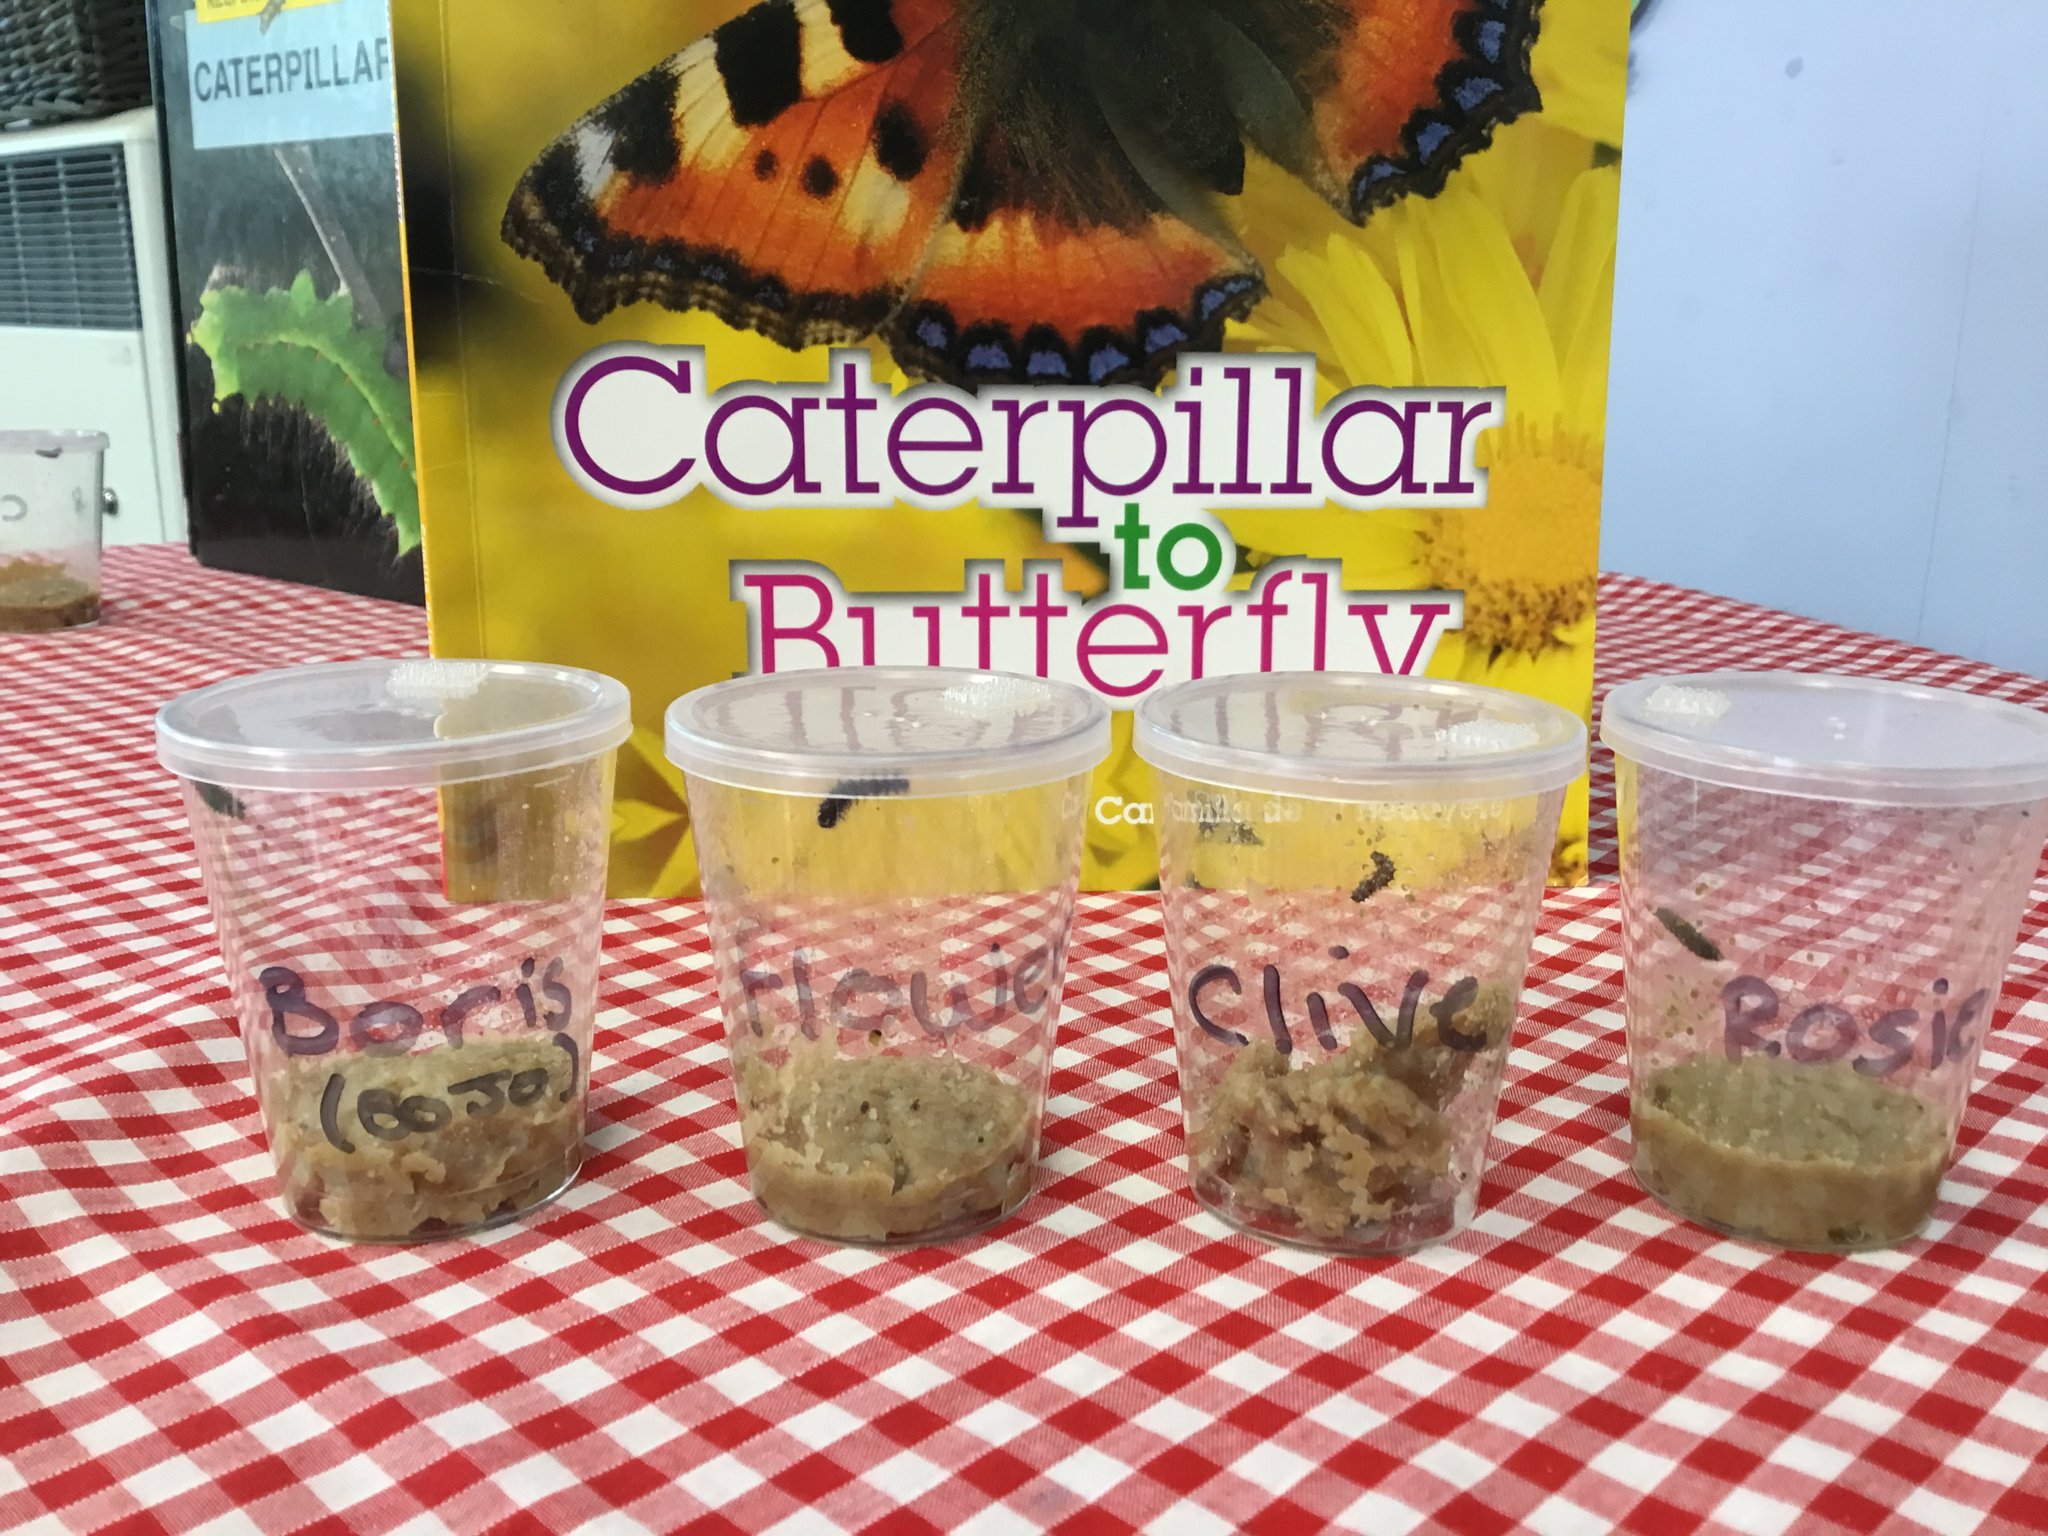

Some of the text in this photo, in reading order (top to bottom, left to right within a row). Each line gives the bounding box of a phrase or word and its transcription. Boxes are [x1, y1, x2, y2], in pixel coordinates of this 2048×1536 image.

[564, 356, 1492, 529] Caterpillar
[1113, 503, 1223, 590] to
[743, 571, 1452, 699] Butterfly
[259, 956, 572, 1058] Boris
[1188, 945, 1487, 1054] Clive
[1721, 975, 1991, 1077] Rosie
